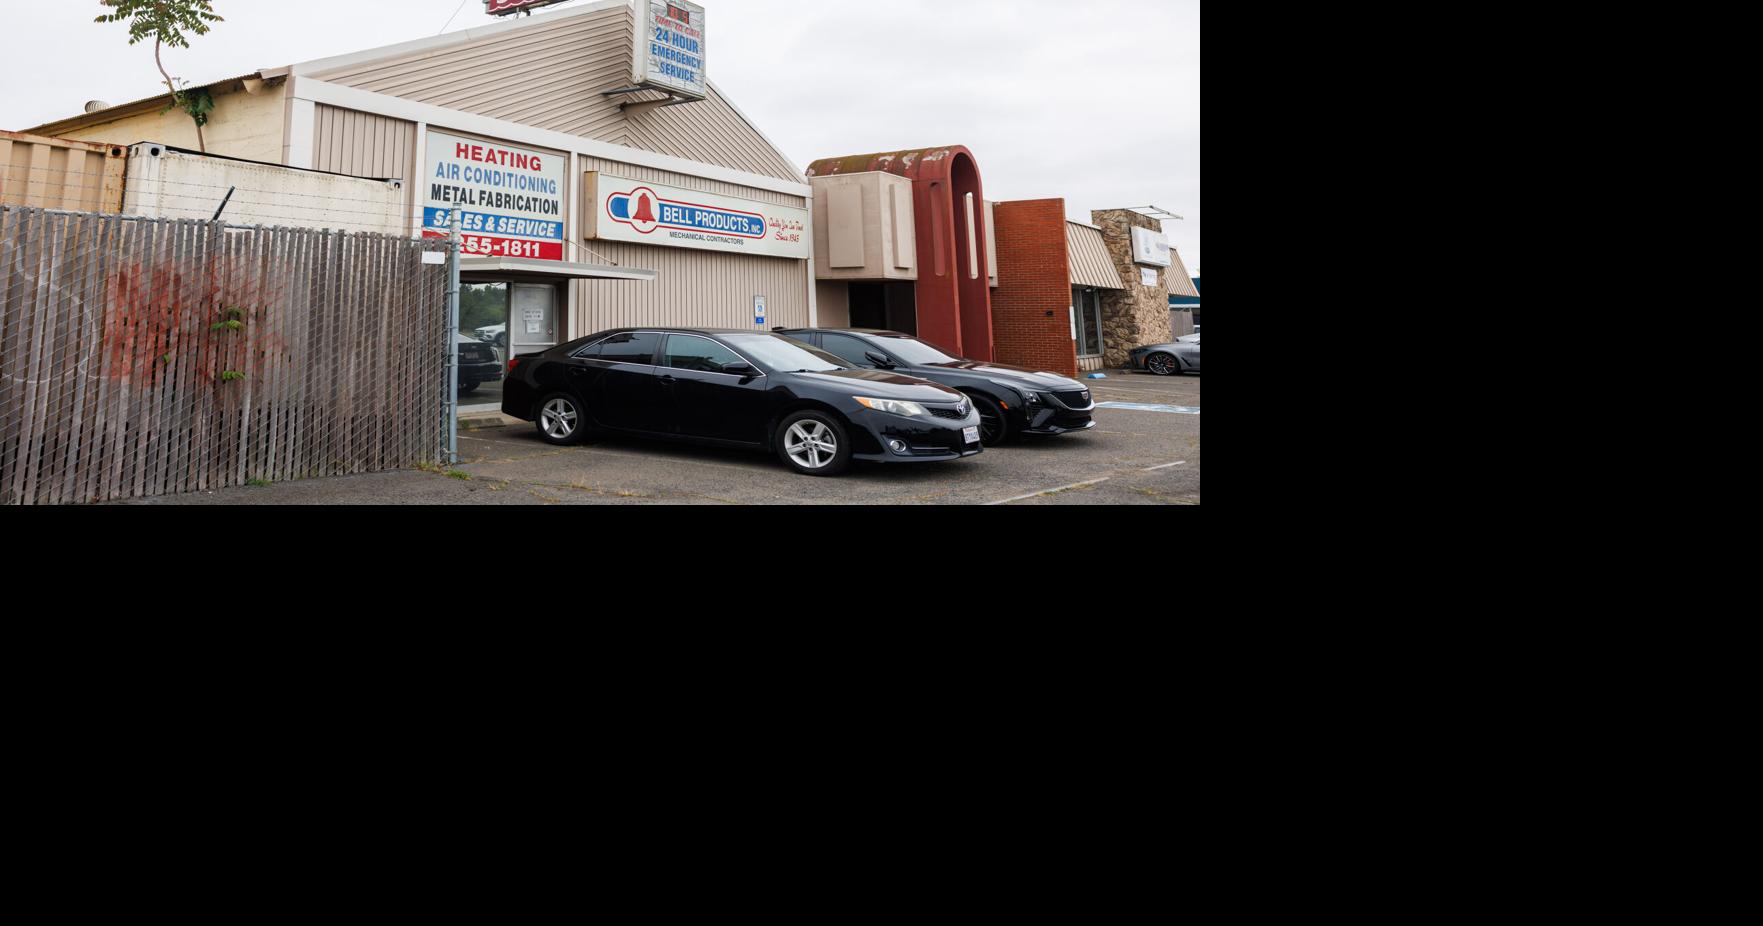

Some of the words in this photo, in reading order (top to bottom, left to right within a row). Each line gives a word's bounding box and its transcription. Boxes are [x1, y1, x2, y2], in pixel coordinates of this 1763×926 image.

[655, 27, 669, 43] 24
[672, 32, 698, 54] HOUR
[651, 44, 701, 69] EMERGENCY
[660, 61, 694, 82] SERVICE
[456, 142, 541, 171] HEATING
[436, 162, 459, 180] AIR
[464, 166, 556, 194] CONDITIONING
[431, 183, 475, 205] METAL
[479, 190, 558, 215] FABRICATION
[433, 210, 483, 232] SAES
[485, 216, 495, 231] &
[498, 218, 556, 237] SERVICE
[663, 206, 692, 224] BELL
[669, 231, 705, 241] MECHANICAL
[706, 235, 744, 246] CONTRACTORS
[775, 231, 788, 241] Since
